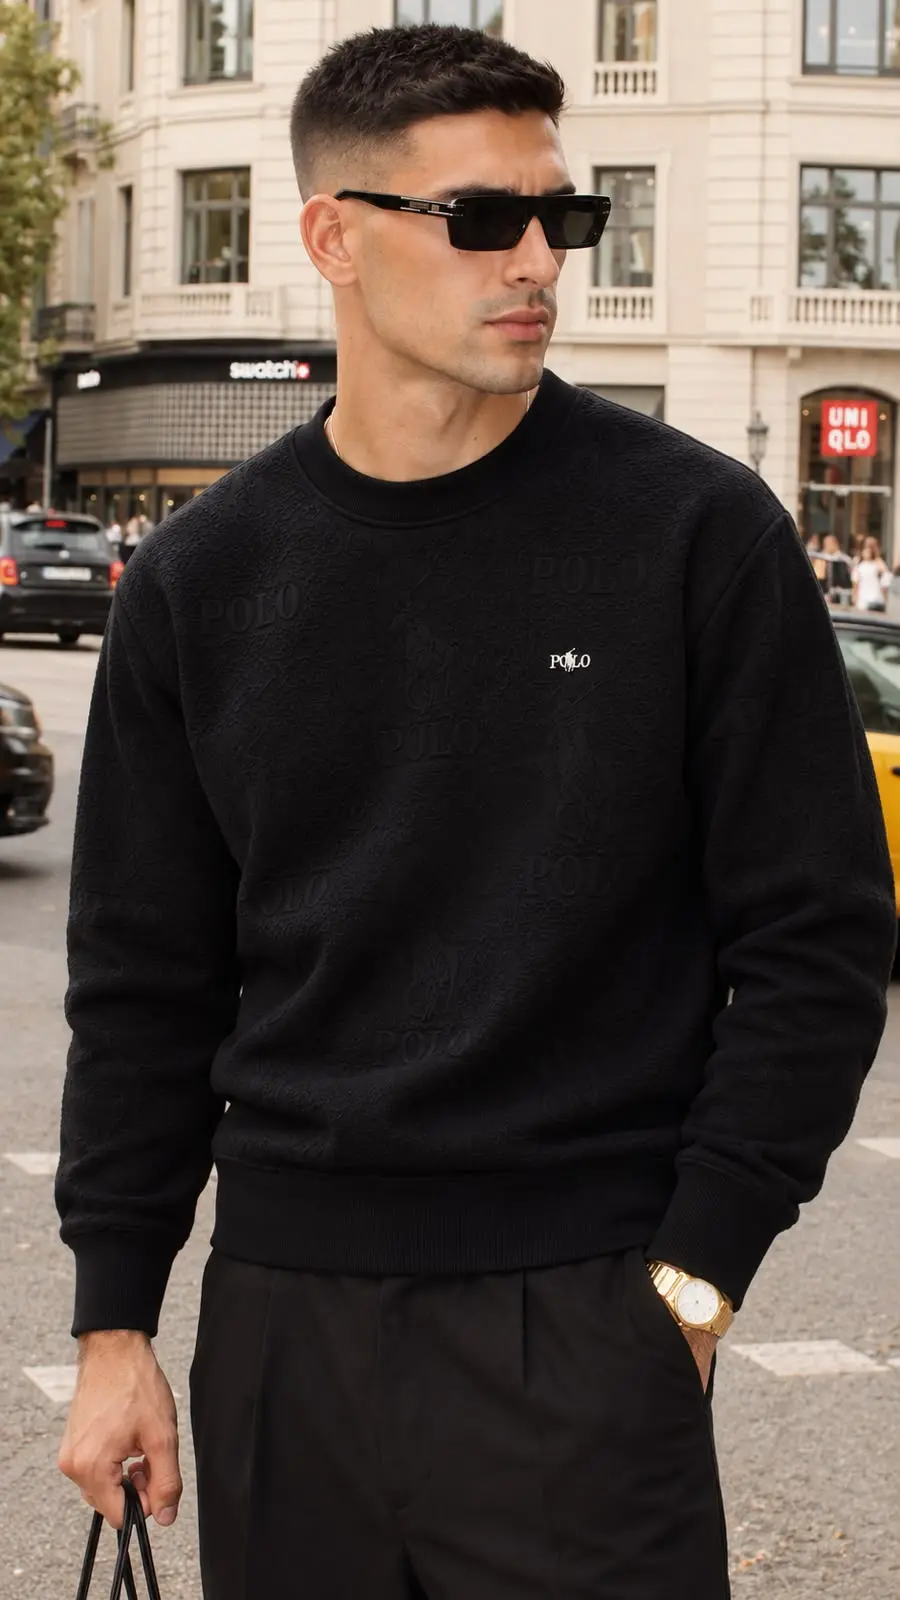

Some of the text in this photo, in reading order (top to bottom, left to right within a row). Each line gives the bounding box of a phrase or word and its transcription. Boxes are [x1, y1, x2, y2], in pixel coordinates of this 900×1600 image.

[230, 360, 297, 379] swatch
[829, 407, 868, 427] UNI
[828, 429, 871, 453] QLO
[200, 583, 299, 634] POLO
